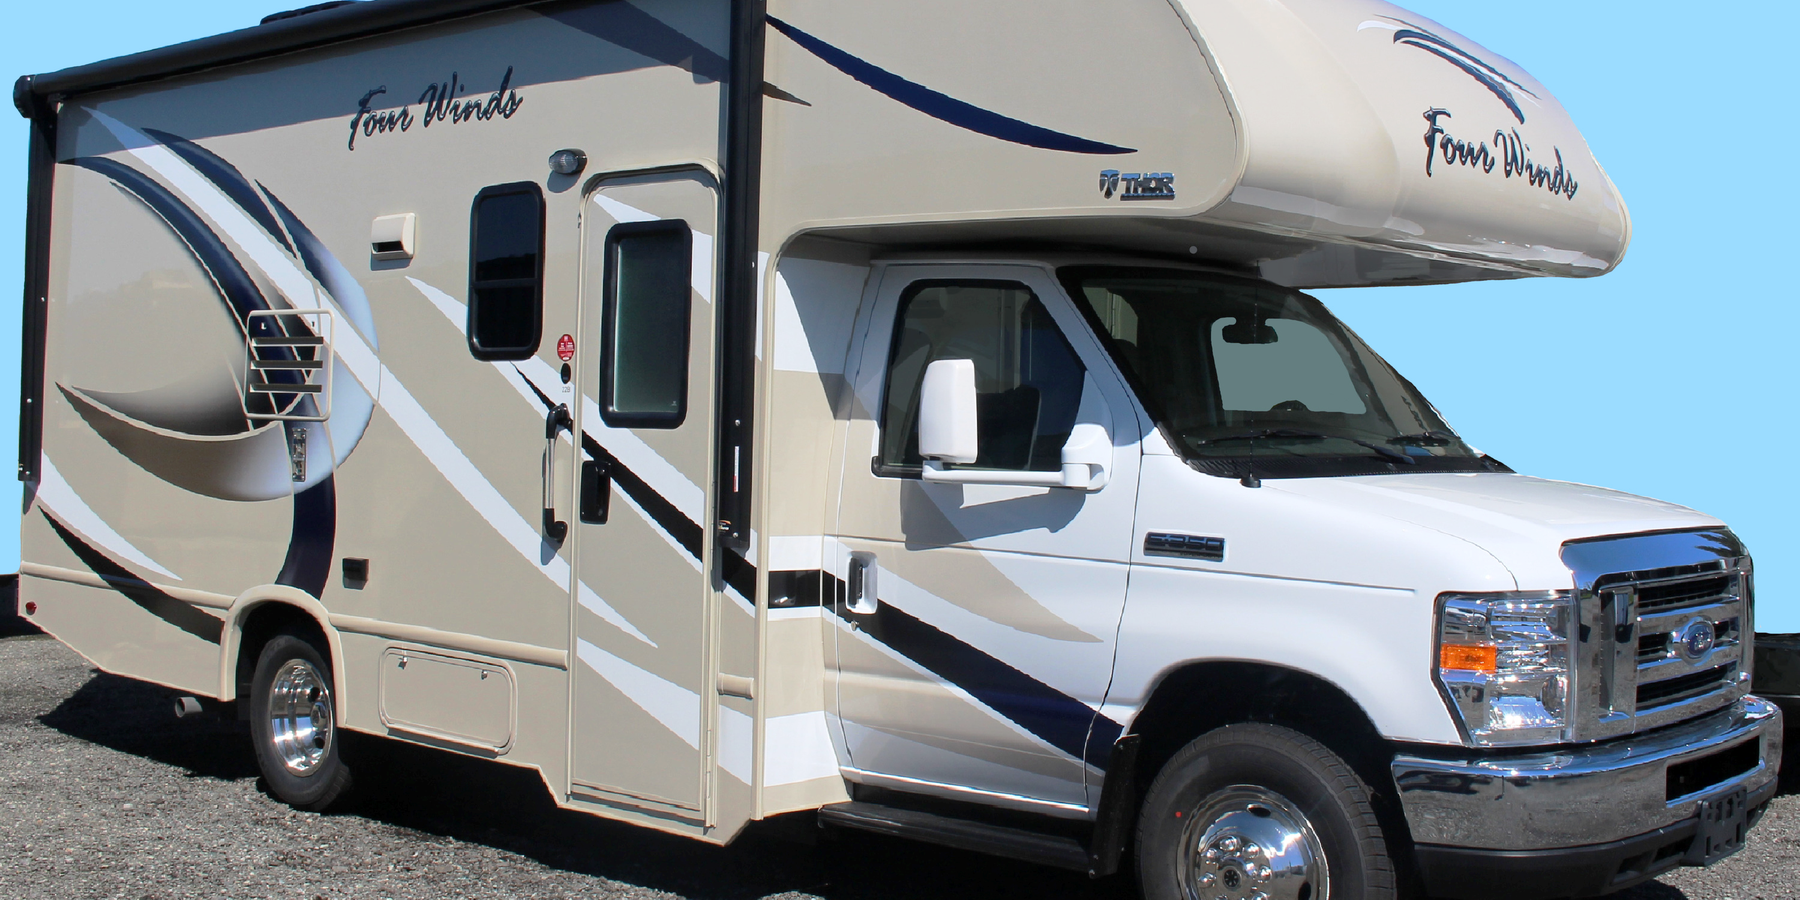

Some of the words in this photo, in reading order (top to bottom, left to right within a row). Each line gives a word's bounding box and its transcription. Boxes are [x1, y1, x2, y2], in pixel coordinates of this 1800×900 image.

[348, 85, 414, 151] Four
[418, 65, 524, 128] Winds
[1120, 172, 1175, 194] THOR
[1423, 106, 1495, 178] Four
[1493, 126, 1578, 201] Winds
